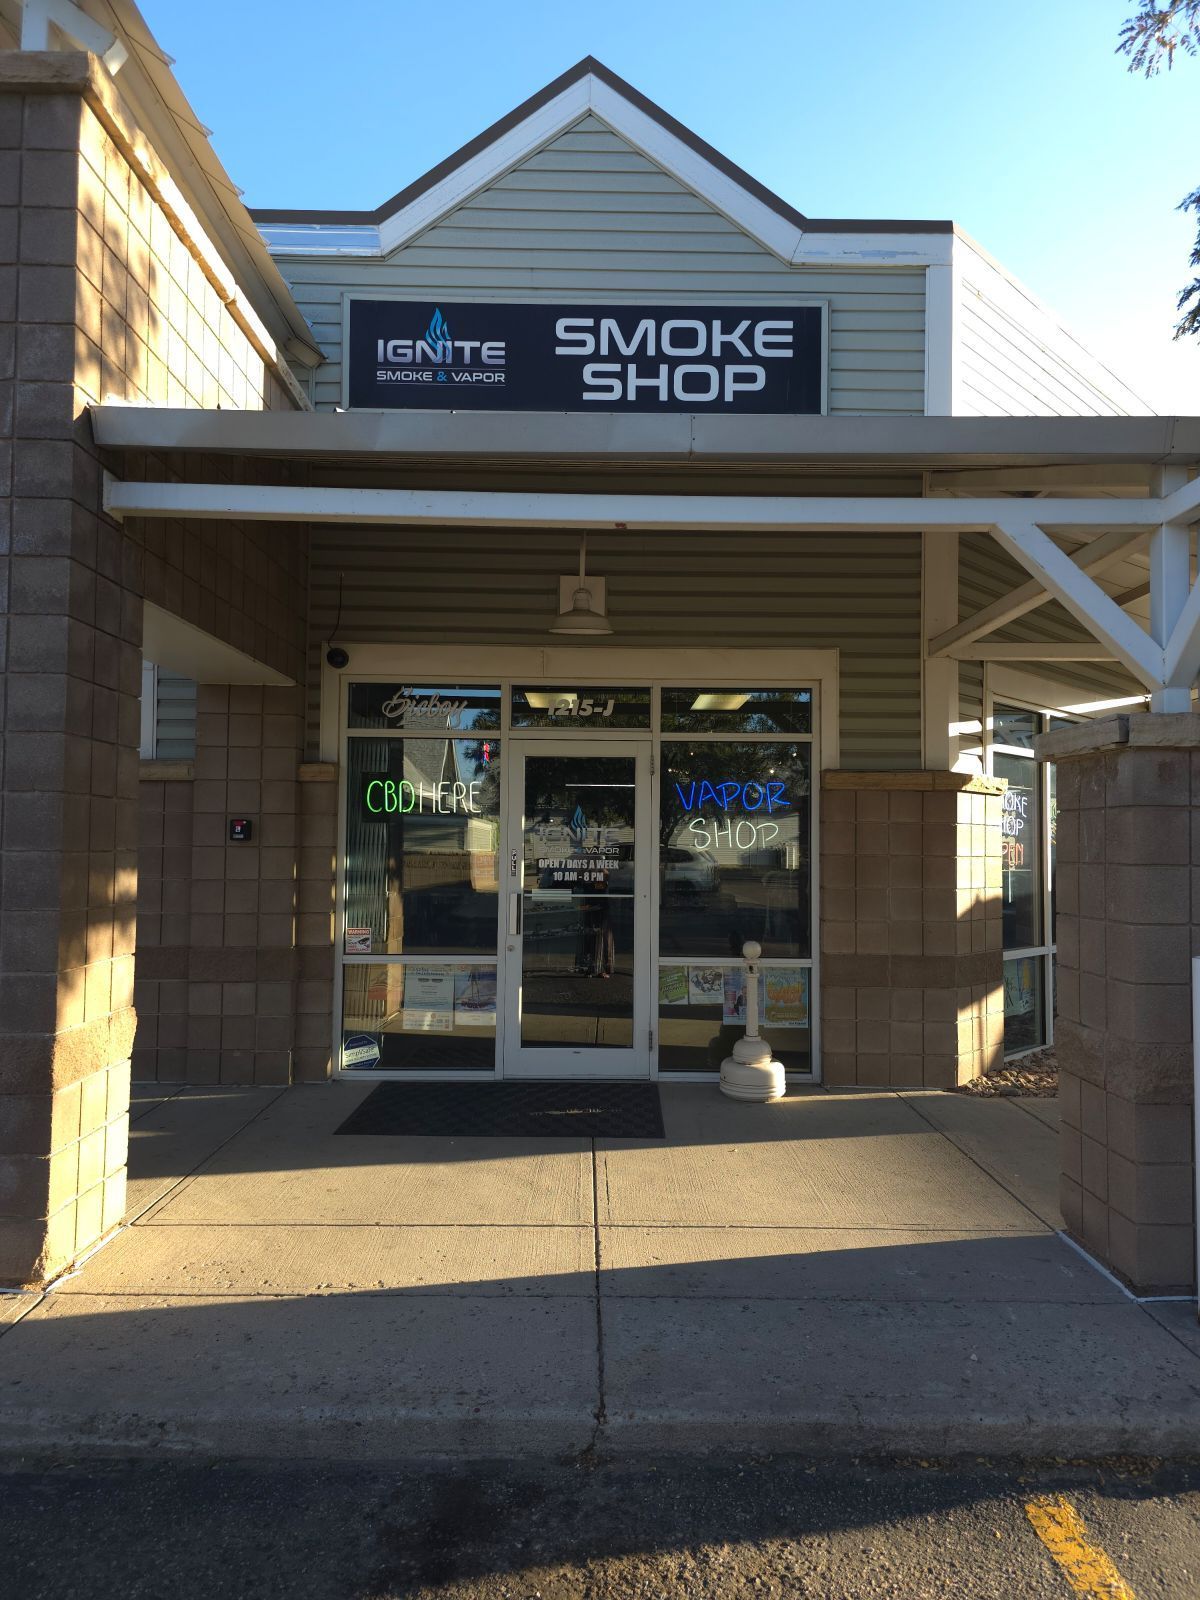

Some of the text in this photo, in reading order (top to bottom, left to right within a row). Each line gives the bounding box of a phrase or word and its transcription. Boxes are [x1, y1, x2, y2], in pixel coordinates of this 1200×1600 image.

[555, 317, 794, 358] SMOKE
[377, 339, 506, 365] IGNITE
[376, 370, 506, 383] SMOKE & VAPOR
[582, 363, 766, 402] SHOP
[547, 699, 615, 717] 1215-J
[366, 780, 482, 814] CBD HERE
[675, 780, 791, 814] VAPOR
[1001, 791, 1028, 818] OKE
[688, 817, 779, 849] SHOP
[1001, 815, 1024, 837] HOP
[585, 847, 620, 855] VAPOR
[1001, 842, 1024, 866] PEN
[538, 859, 619, 869] OPEN 7 DAYS A WEEK
[553, 872, 563, 881] 10
[564, 872, 578, 881] AM
[583, 872, 589, 881] 8
[591, 872, 604, 881] PM
